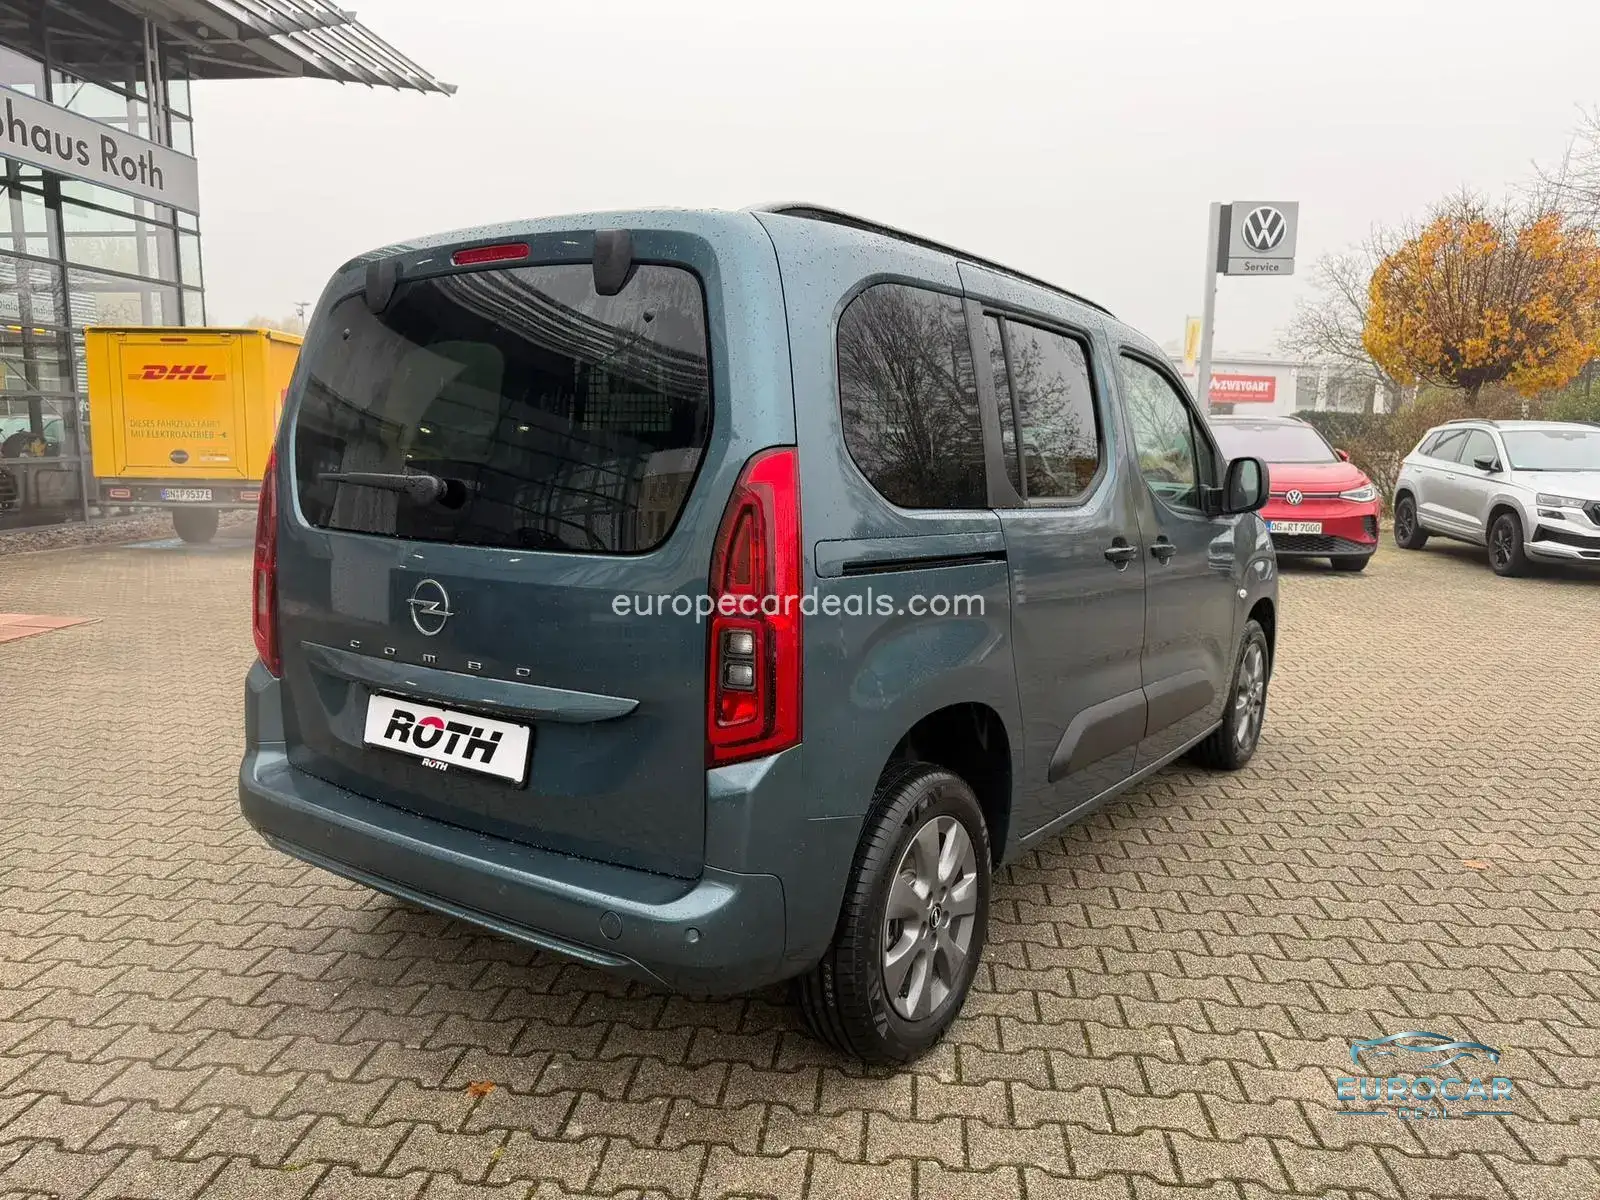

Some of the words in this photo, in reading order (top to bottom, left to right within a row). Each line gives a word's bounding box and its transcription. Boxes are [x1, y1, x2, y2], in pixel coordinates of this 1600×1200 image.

[100, 133, 164, 190] Roth
[1244, 261, 1279, 272] Service
[142, 365, 212, 380] DHL
[350, 640, 531, 677] COMBO
[384, 709, 503, 764] ROTH
[421, 757, 449, 771] ROTH
